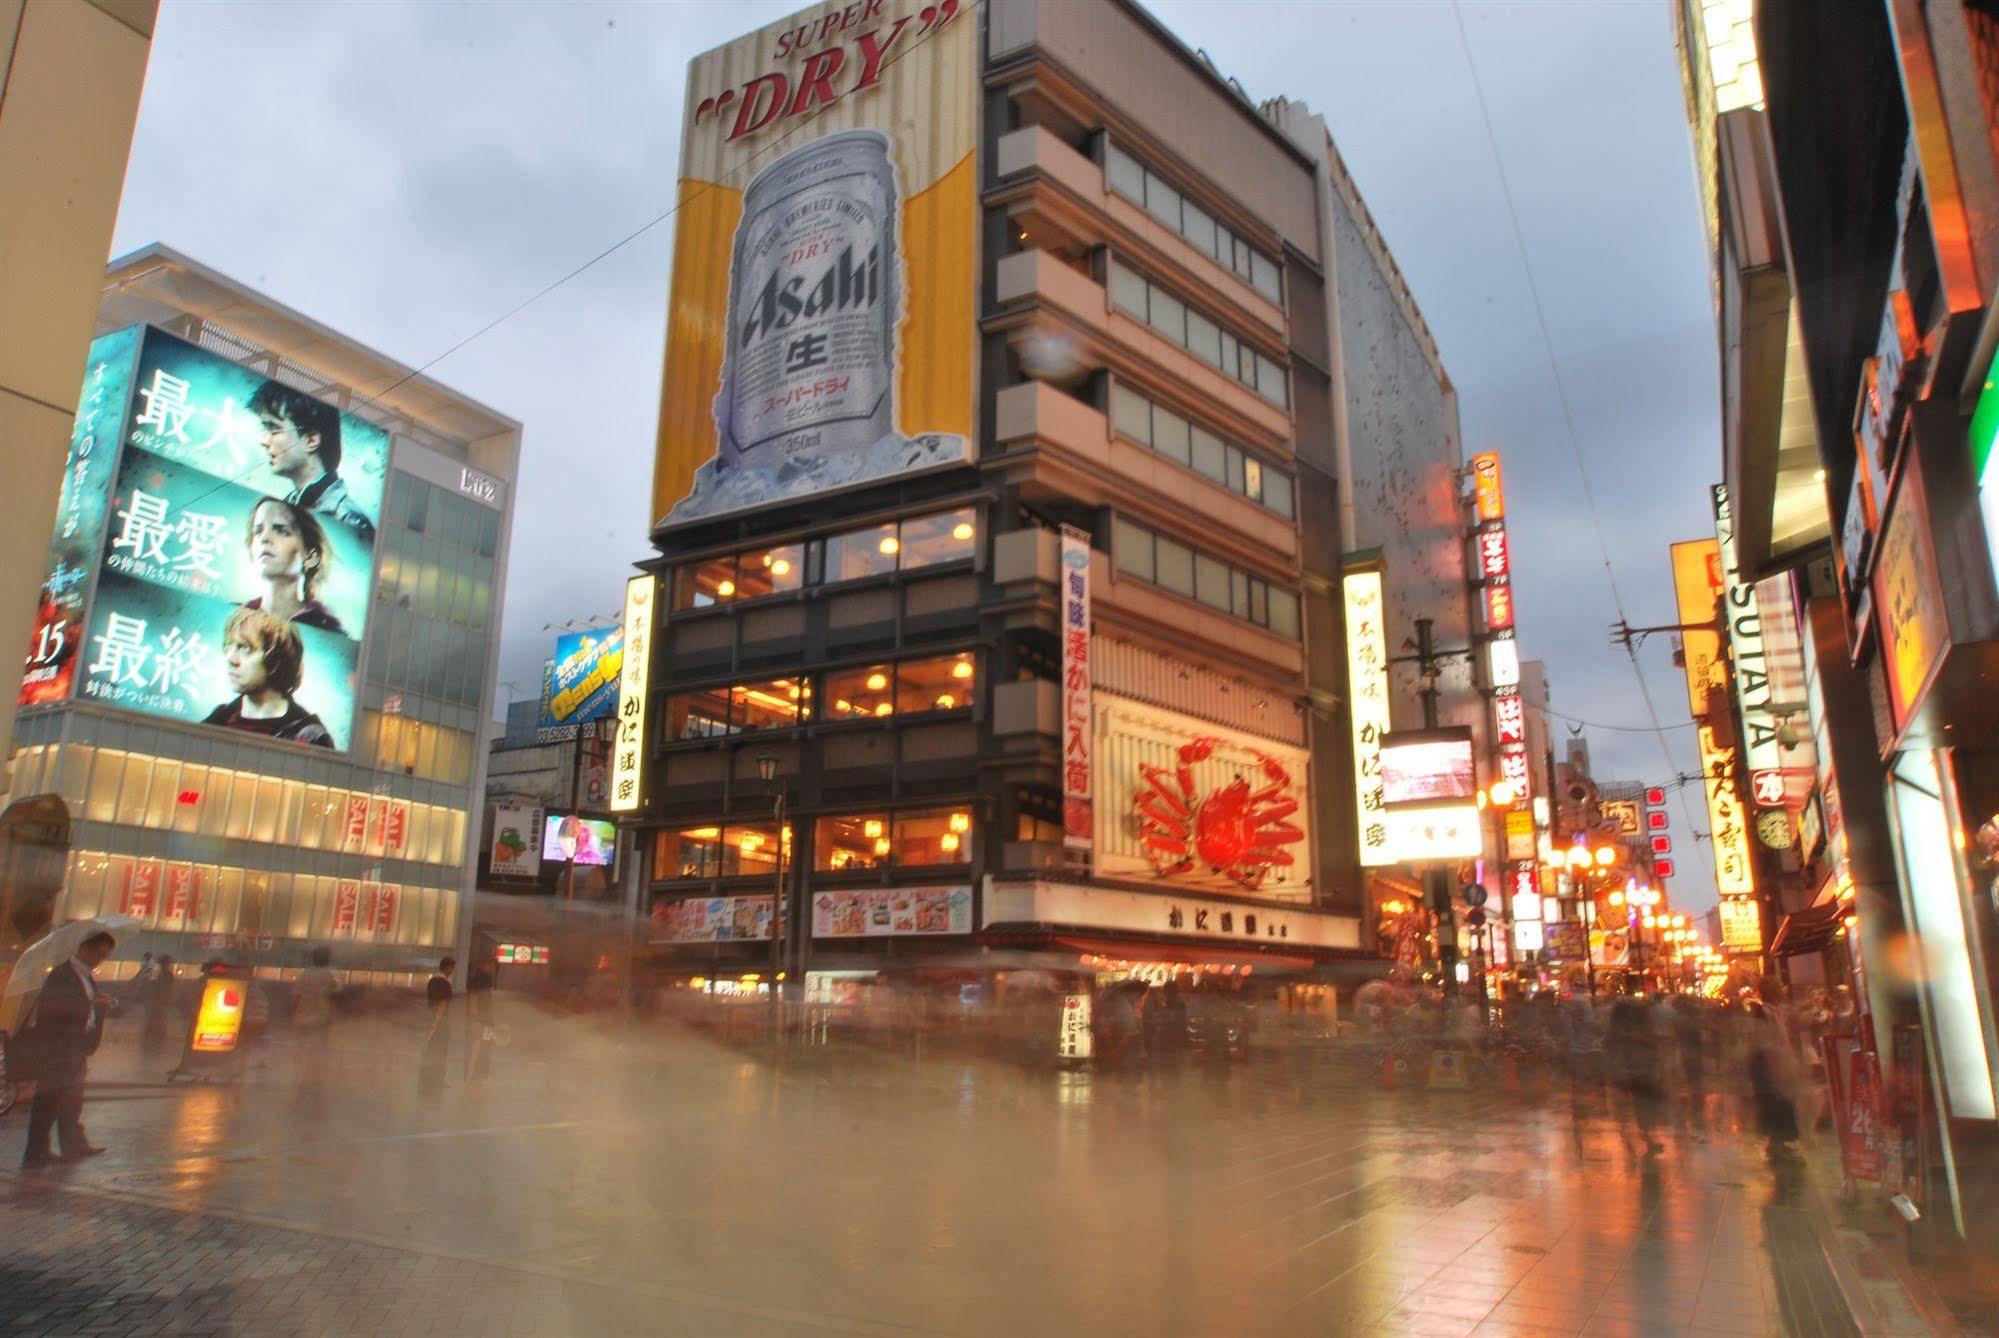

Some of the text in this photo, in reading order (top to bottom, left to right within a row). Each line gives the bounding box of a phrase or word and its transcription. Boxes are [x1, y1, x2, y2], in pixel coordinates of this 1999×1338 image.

[742, 245, 878, 349] Asahi
[763, 376, 851, 416] スーパードライ
[786, 333, 828, 374] 生
[113, 488, 228, 579] 最愛
[89, 611, 216, 697] 最終
[617, 695, 641, 802] かに道楽
[346, 799, 368, 851] SALE
